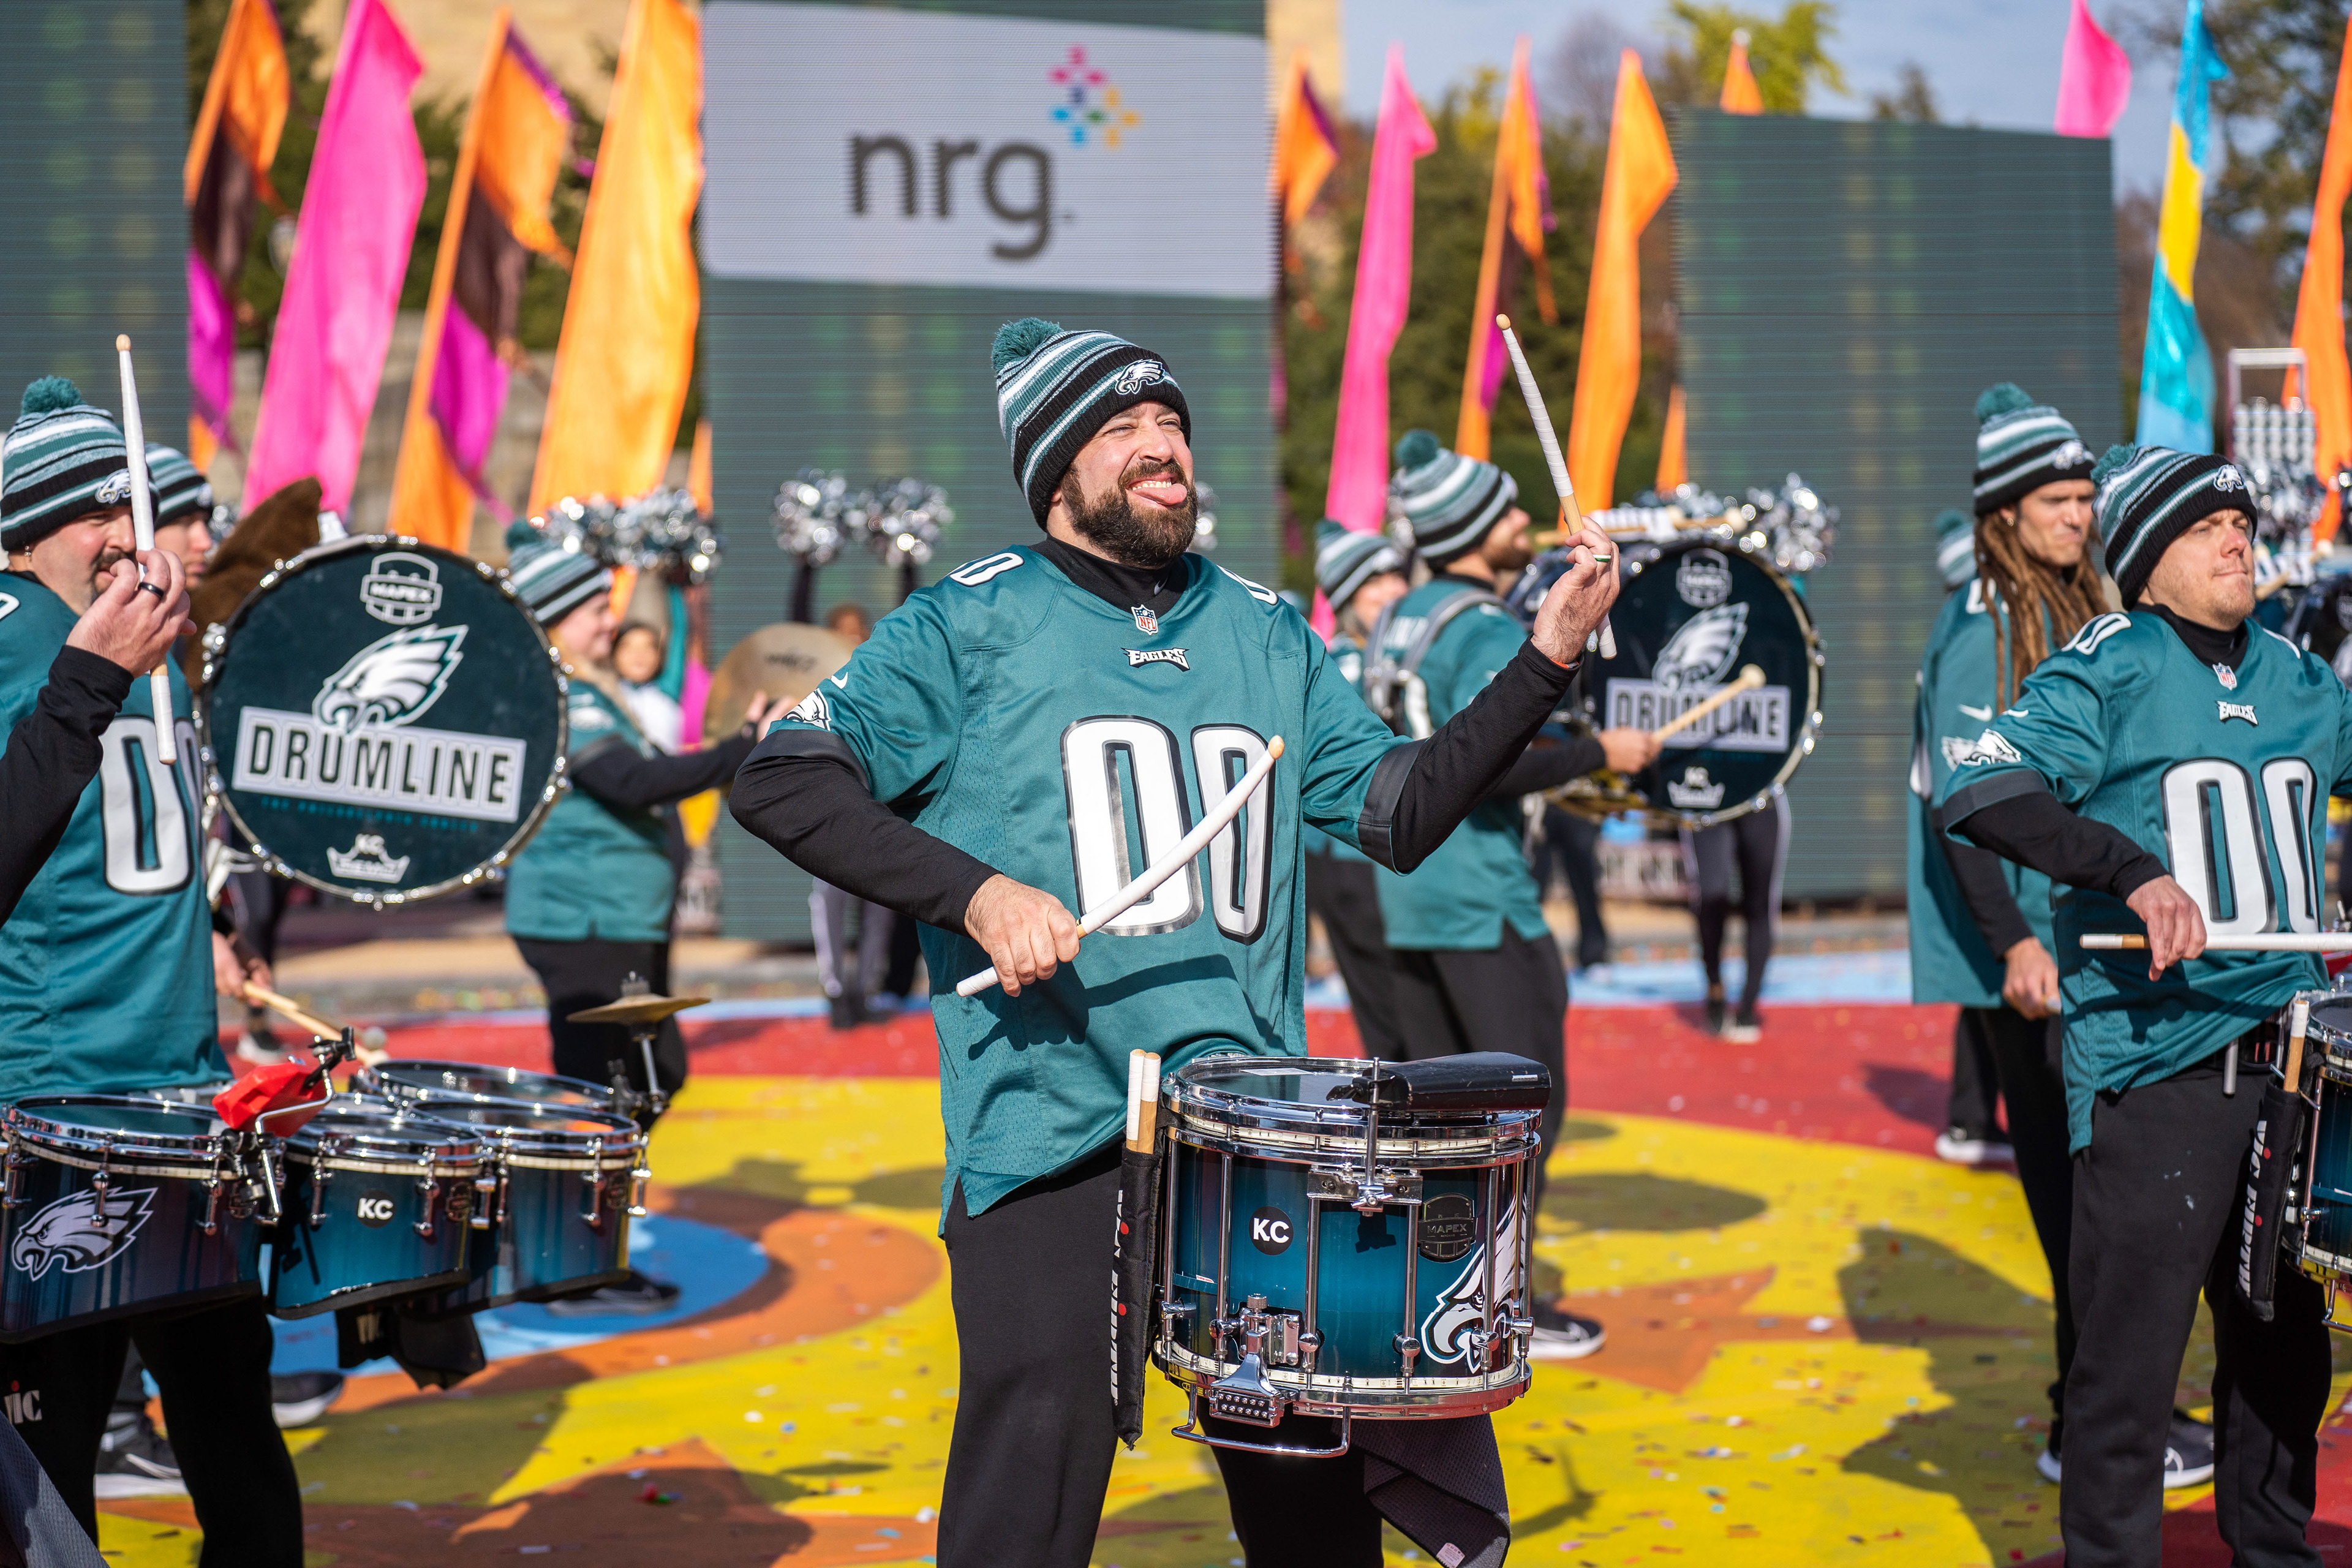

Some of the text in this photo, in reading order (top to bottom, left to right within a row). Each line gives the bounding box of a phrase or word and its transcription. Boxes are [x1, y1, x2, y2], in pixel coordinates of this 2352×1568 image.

[851, 135, 1053, 260] nrg
[1139, 616, 1156, 630] NFL
[1121, 647, 1190, 671] EAGLES
[2215, 700, 2259, 726] EAGLES
[247, 722, 511, 805] DRUMLINE
[1060, 715, 1275, 944] 00
[2160, 757, 2320, 933] 00
[357, 1197, 393, 1220] KC
[1253, 1217, 1289, 1243] KC
[1427, 1223, 1468, 1235] MAPEX
